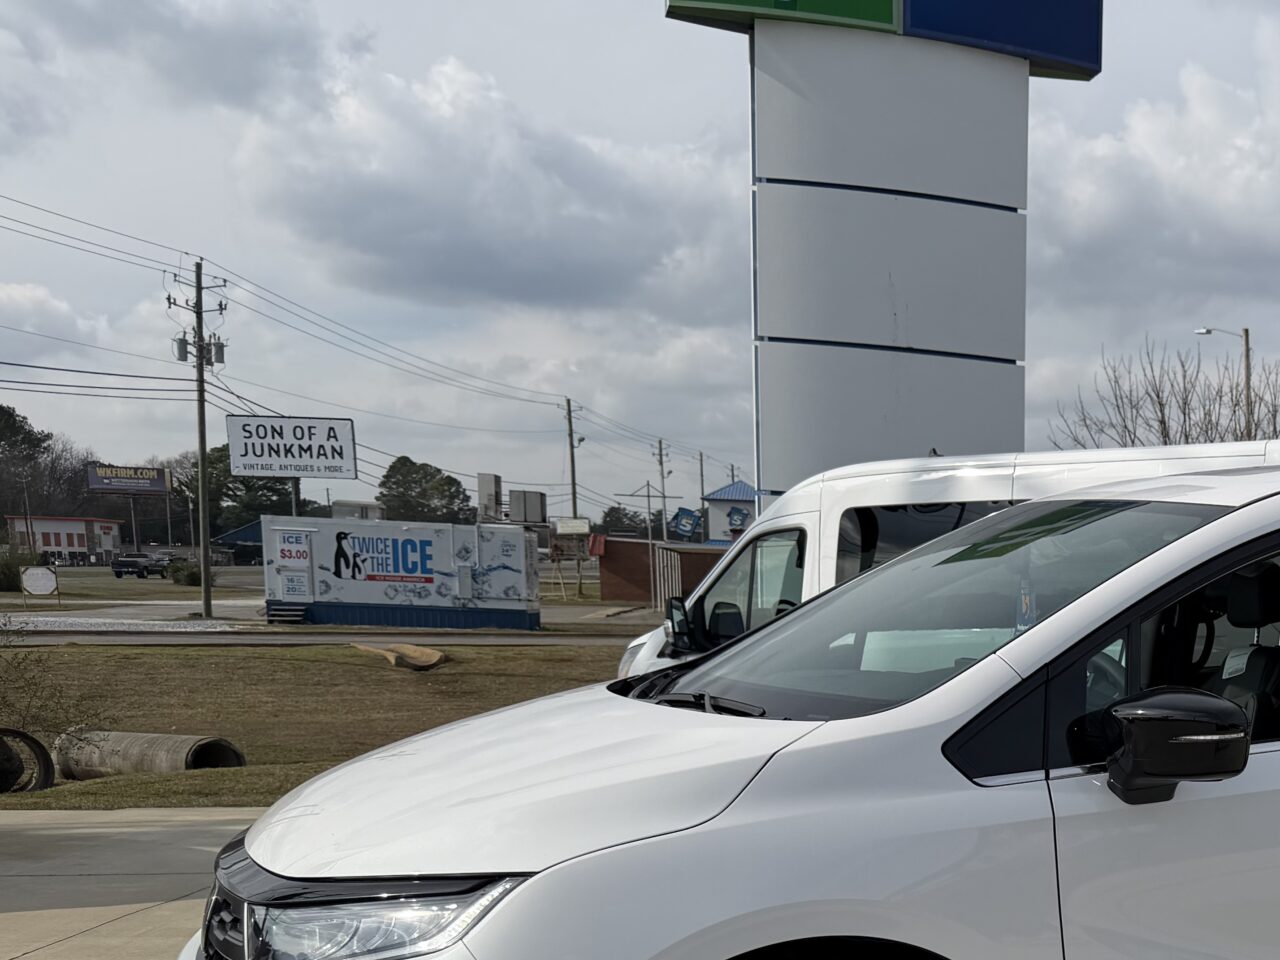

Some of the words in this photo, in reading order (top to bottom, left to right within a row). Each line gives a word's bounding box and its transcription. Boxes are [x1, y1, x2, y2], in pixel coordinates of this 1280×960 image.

[242, 423, 284, 440] SON
[292, 425, 317, 441] OF
[326, 426, 339, 442] A
[240, 442, 344, 460] JUNKMAN
[96, 467, 158, 479] WKFIRM.COM
[243, 463, 276, 471] VINTAGE,
[278, 464, 315, 473] ANTIQUES
[324, 465, 344, 473] MORE
[282, 535, 303, 544] ICE
[350, 536, 390, 555] TWICE
[280, 548, 308, 560] $3.00
[392, 538, 434, 575] ICE
[369, 556, 391, 573] THE
